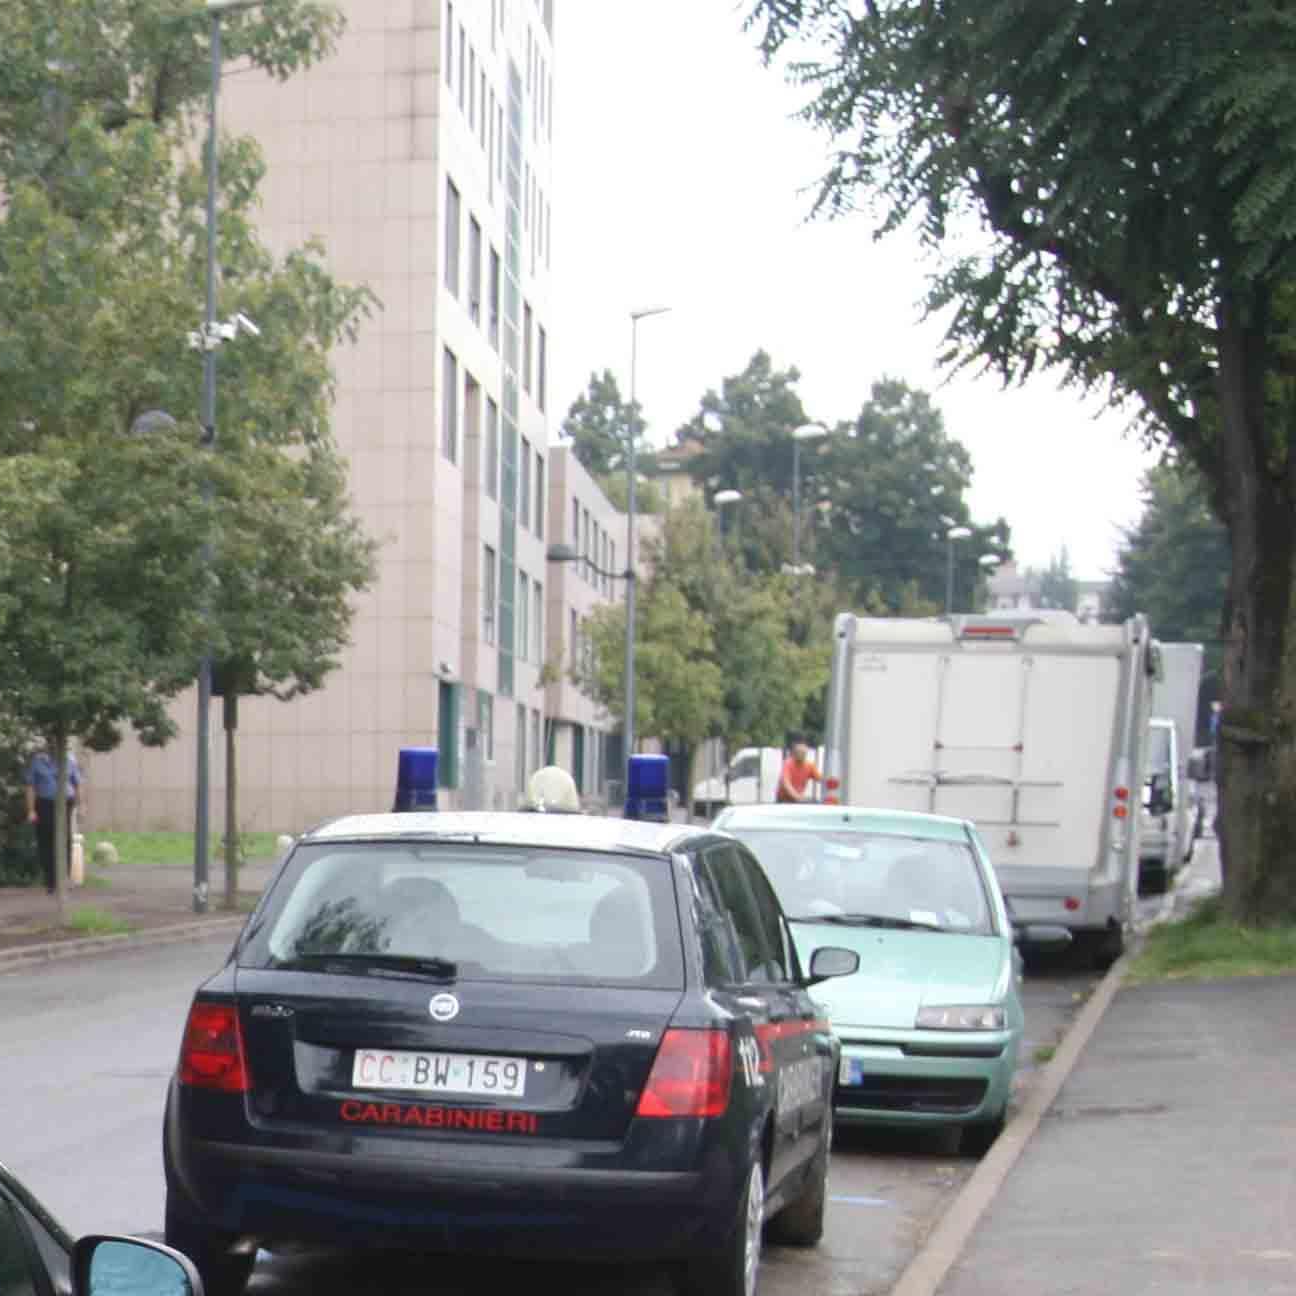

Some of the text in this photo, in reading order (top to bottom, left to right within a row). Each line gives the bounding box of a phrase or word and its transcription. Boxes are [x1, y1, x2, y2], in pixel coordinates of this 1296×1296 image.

[360, 1055, 520, 1090] CC BW 159
[340, 1099, 539, 1135] CARABINIERI
